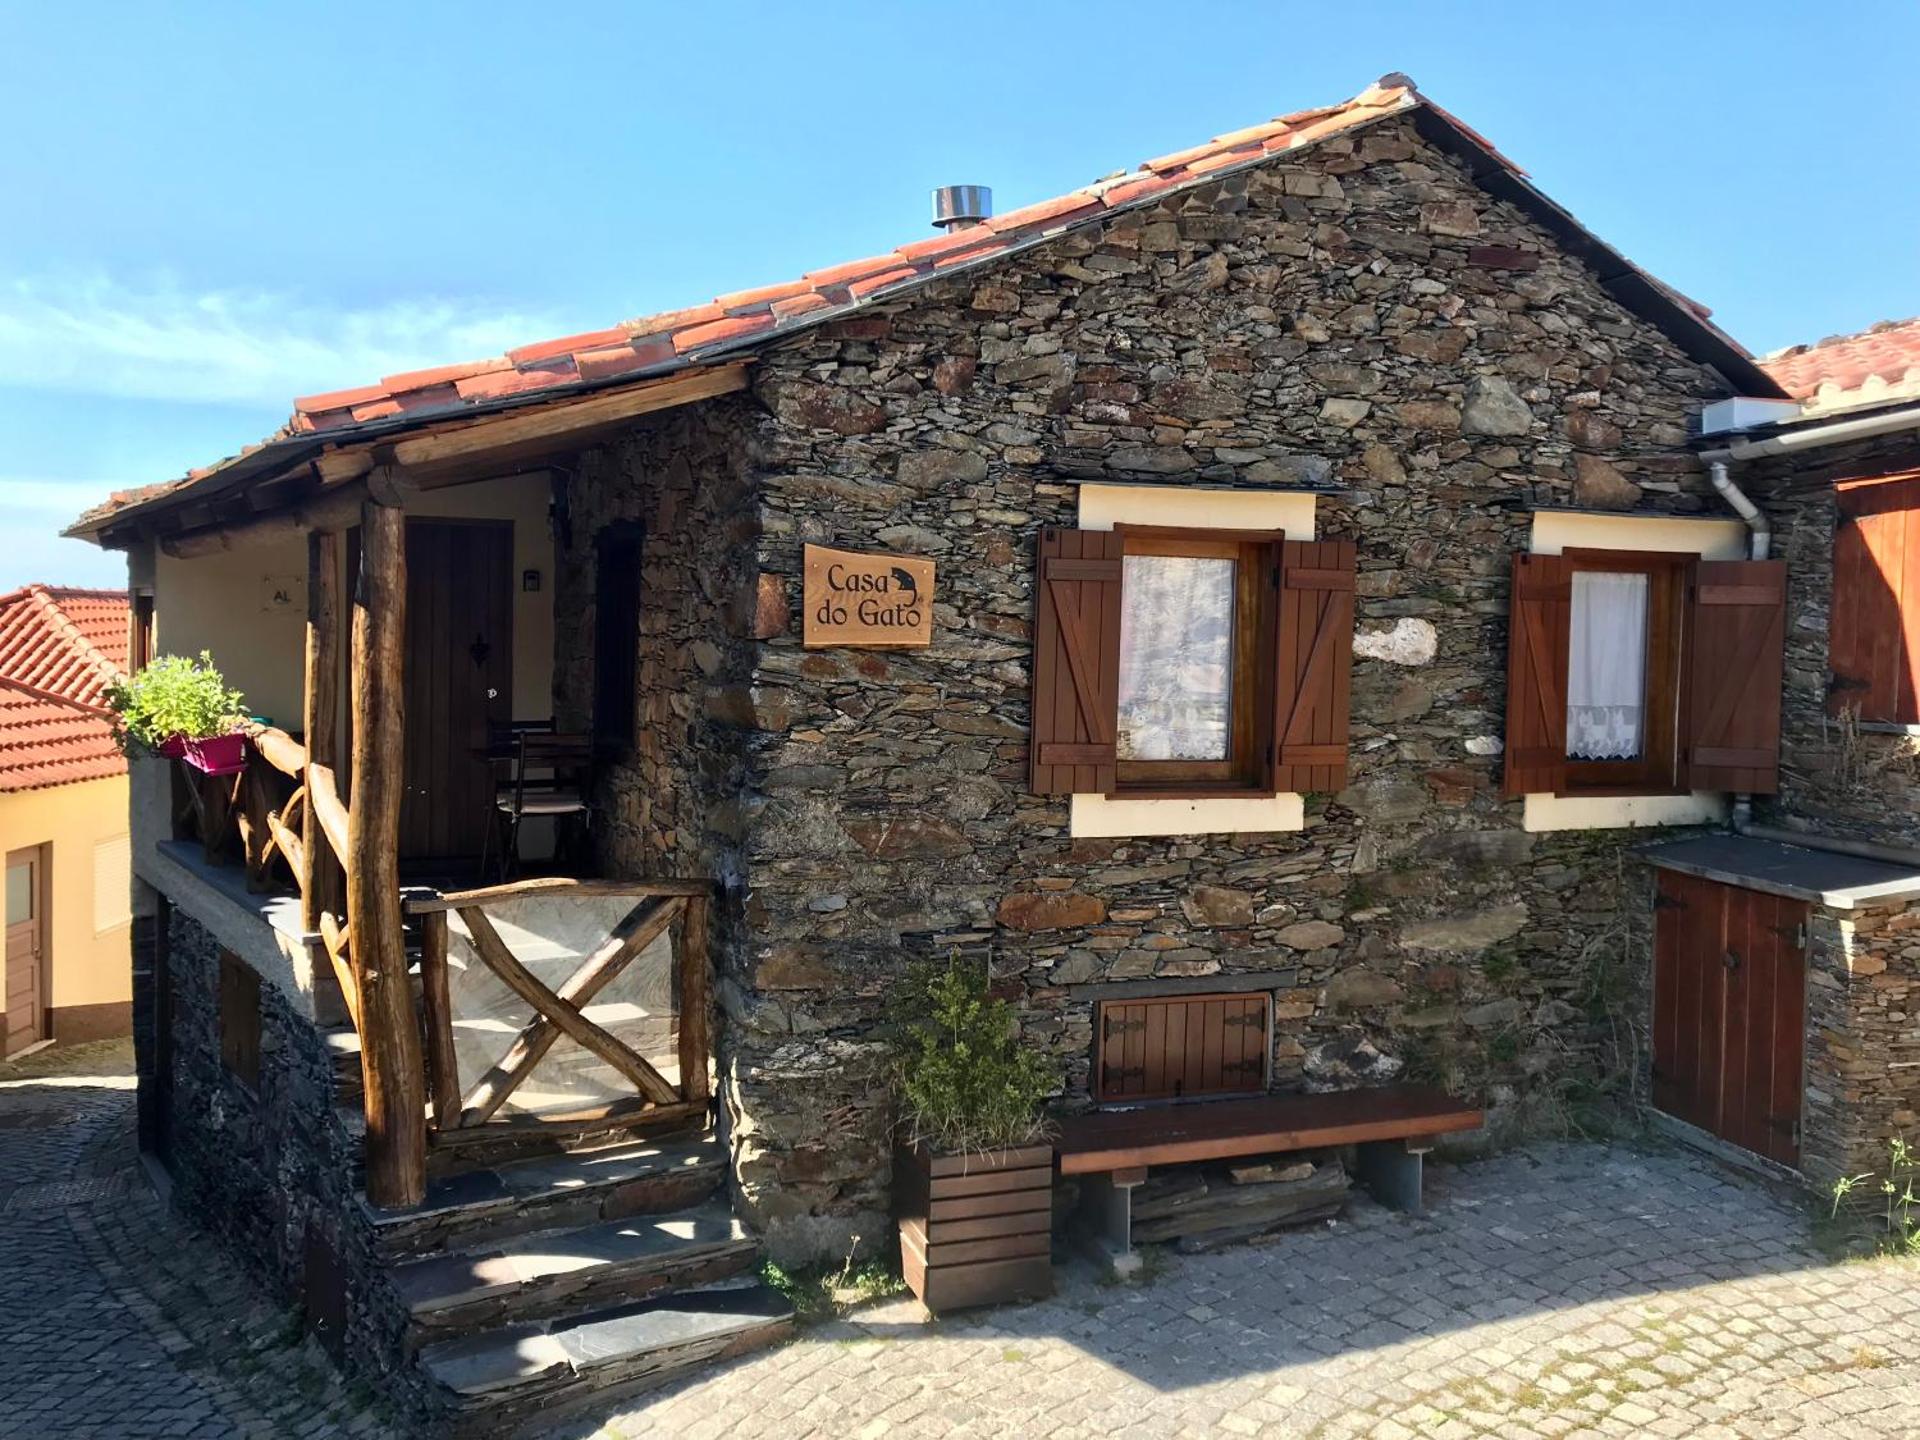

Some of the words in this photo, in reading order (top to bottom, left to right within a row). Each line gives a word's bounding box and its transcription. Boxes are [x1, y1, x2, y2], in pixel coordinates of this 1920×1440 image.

[827, 564, 888, 593] Casa
[273, 591, 291, 602] AL
[816, 599, 848, 625] do
[857, 599, 921, 627] Gato
